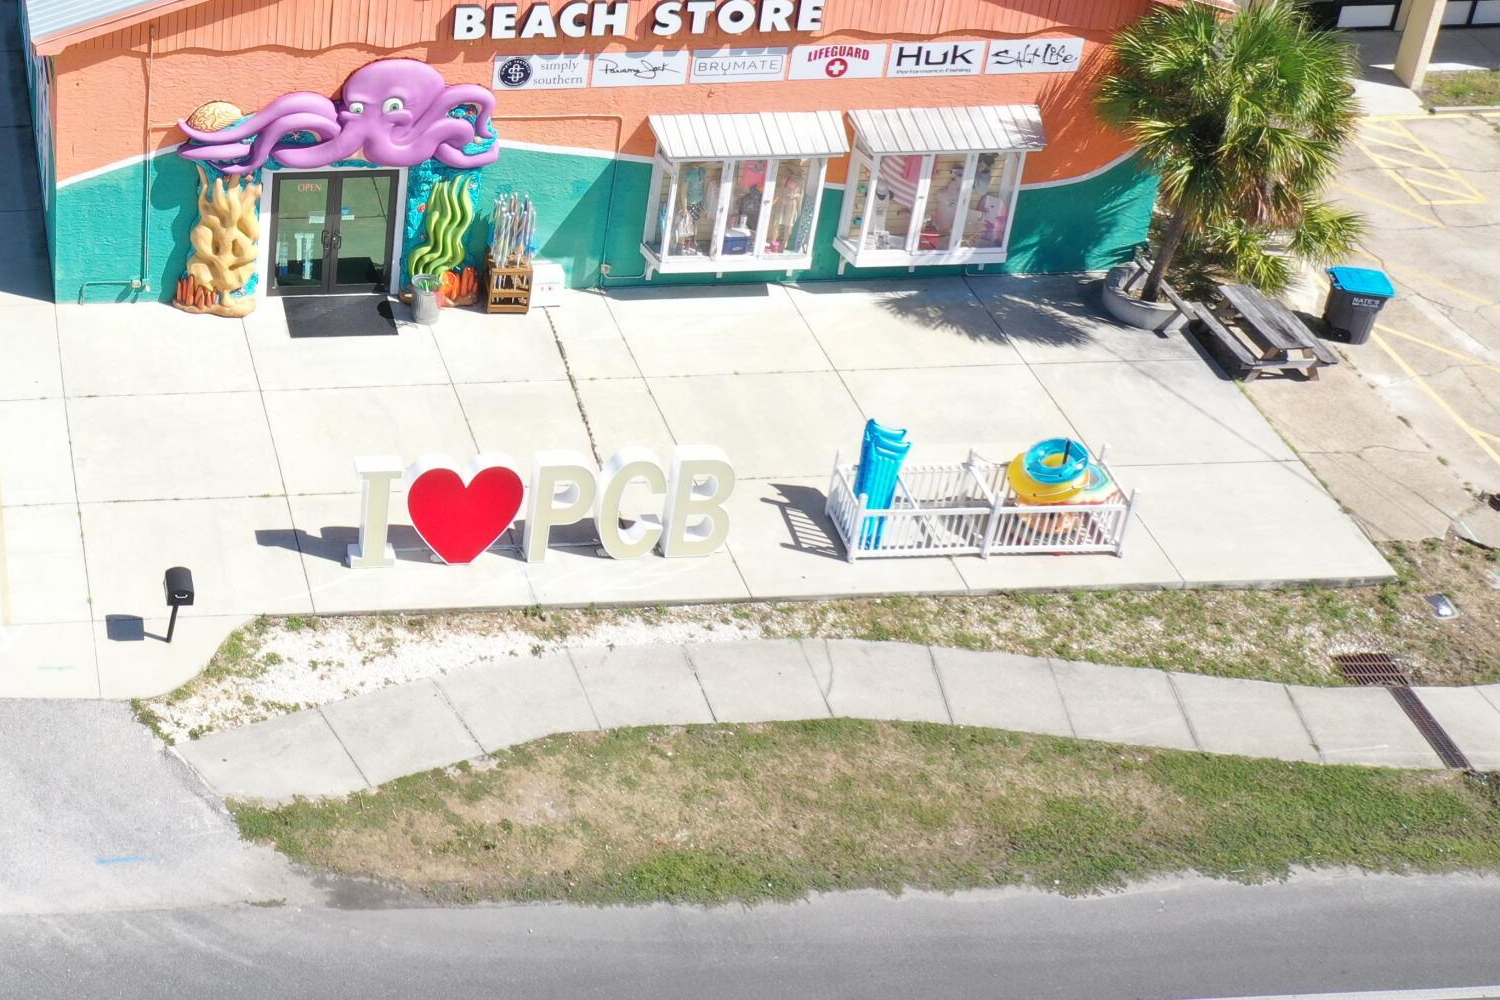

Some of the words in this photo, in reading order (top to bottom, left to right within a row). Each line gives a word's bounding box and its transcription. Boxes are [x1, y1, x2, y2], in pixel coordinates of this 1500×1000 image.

[807, 45, 871, 63] LIFEGUARD
[540, 59, 580, 72] simply
[533, 74, 583, 86] southern
[297, 183, 323, 193] OPEN
[345, 455, 402, 569] I
[522, 446, 737, 563] PCB
